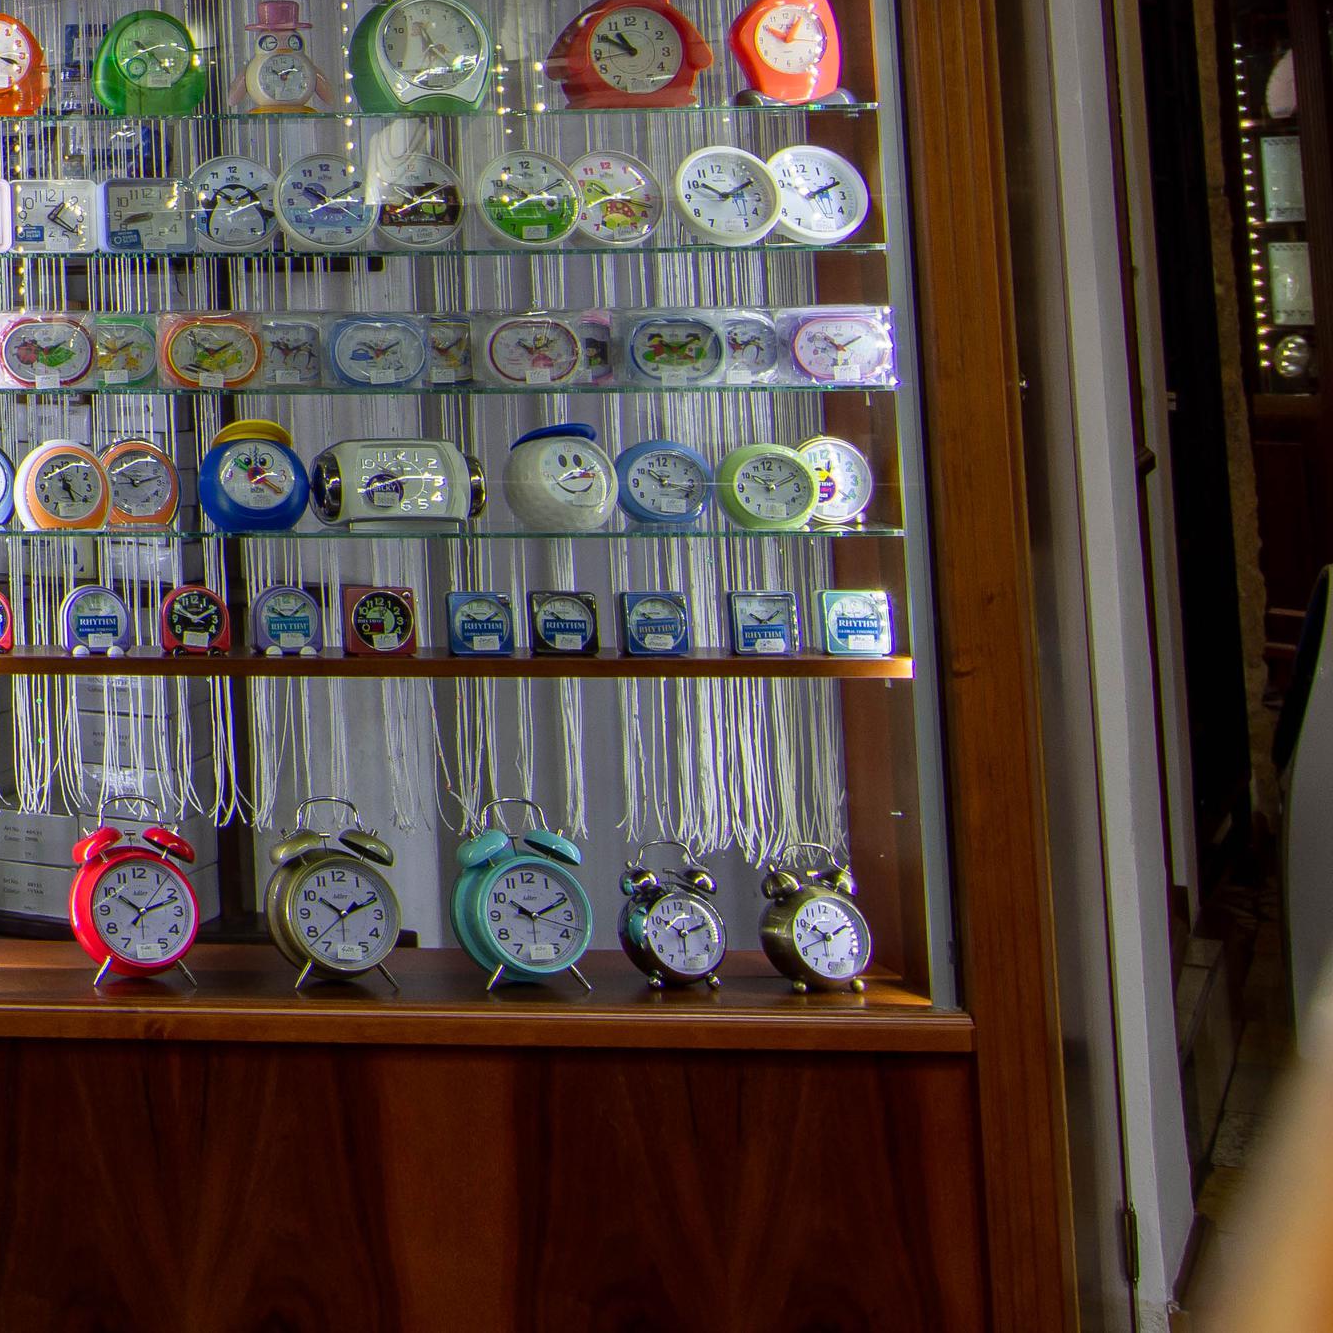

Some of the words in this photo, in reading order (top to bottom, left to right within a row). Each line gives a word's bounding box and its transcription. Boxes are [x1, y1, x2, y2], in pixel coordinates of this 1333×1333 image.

[80, 618, 117, 626] RHYTHM
[270, 623, 308, 631] RHYTHM
[464, 621, 502, 630] RHYTHM
[546, 621, 585, 630] RHYTHM
[838, 619, 878, 628] RHYTHM
[745, 631, 782, 639] RHYTHM
[132, 868, 147, 879] 12
[332, 871, 346, 882] 12
[520, 872, 535, 884] 12
[303, 891, 316, 901] 10
[99, 905, 110, 916] 9
[174, 906, 183, 917] 3
[107, 923, 118, 934] 8
[559, 928, 571, 940] 4
